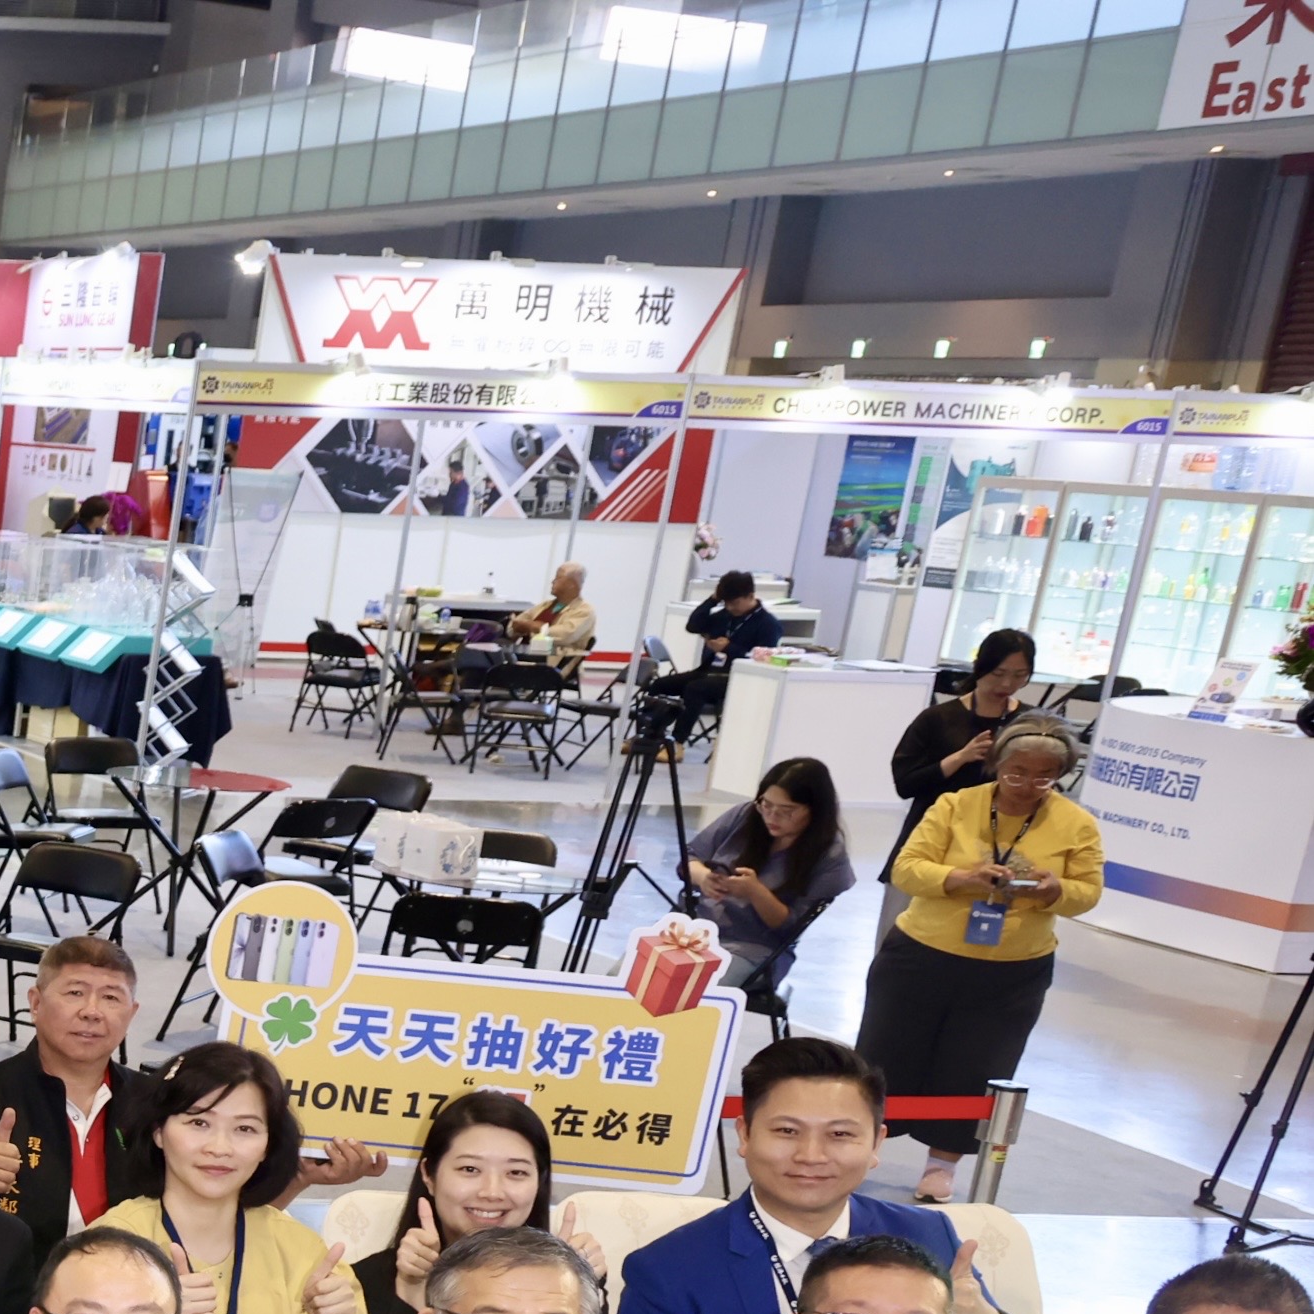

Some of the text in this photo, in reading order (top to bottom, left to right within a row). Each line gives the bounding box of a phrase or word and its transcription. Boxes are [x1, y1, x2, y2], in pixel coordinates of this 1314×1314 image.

[1201, 60, 1311, 118] East
[455, 282, 676, 326] 萬明機械
[651, 405, 677, 416] 6015
[1046, 406, 1105, 426] CORP.
[1135, 420, 1163, 433] 6015
[1160, 749, 1208, 769] Company
[333, 1004, 665, 1085] 天天抽好禮
[551, 1104, 673, 1147] 在必得
